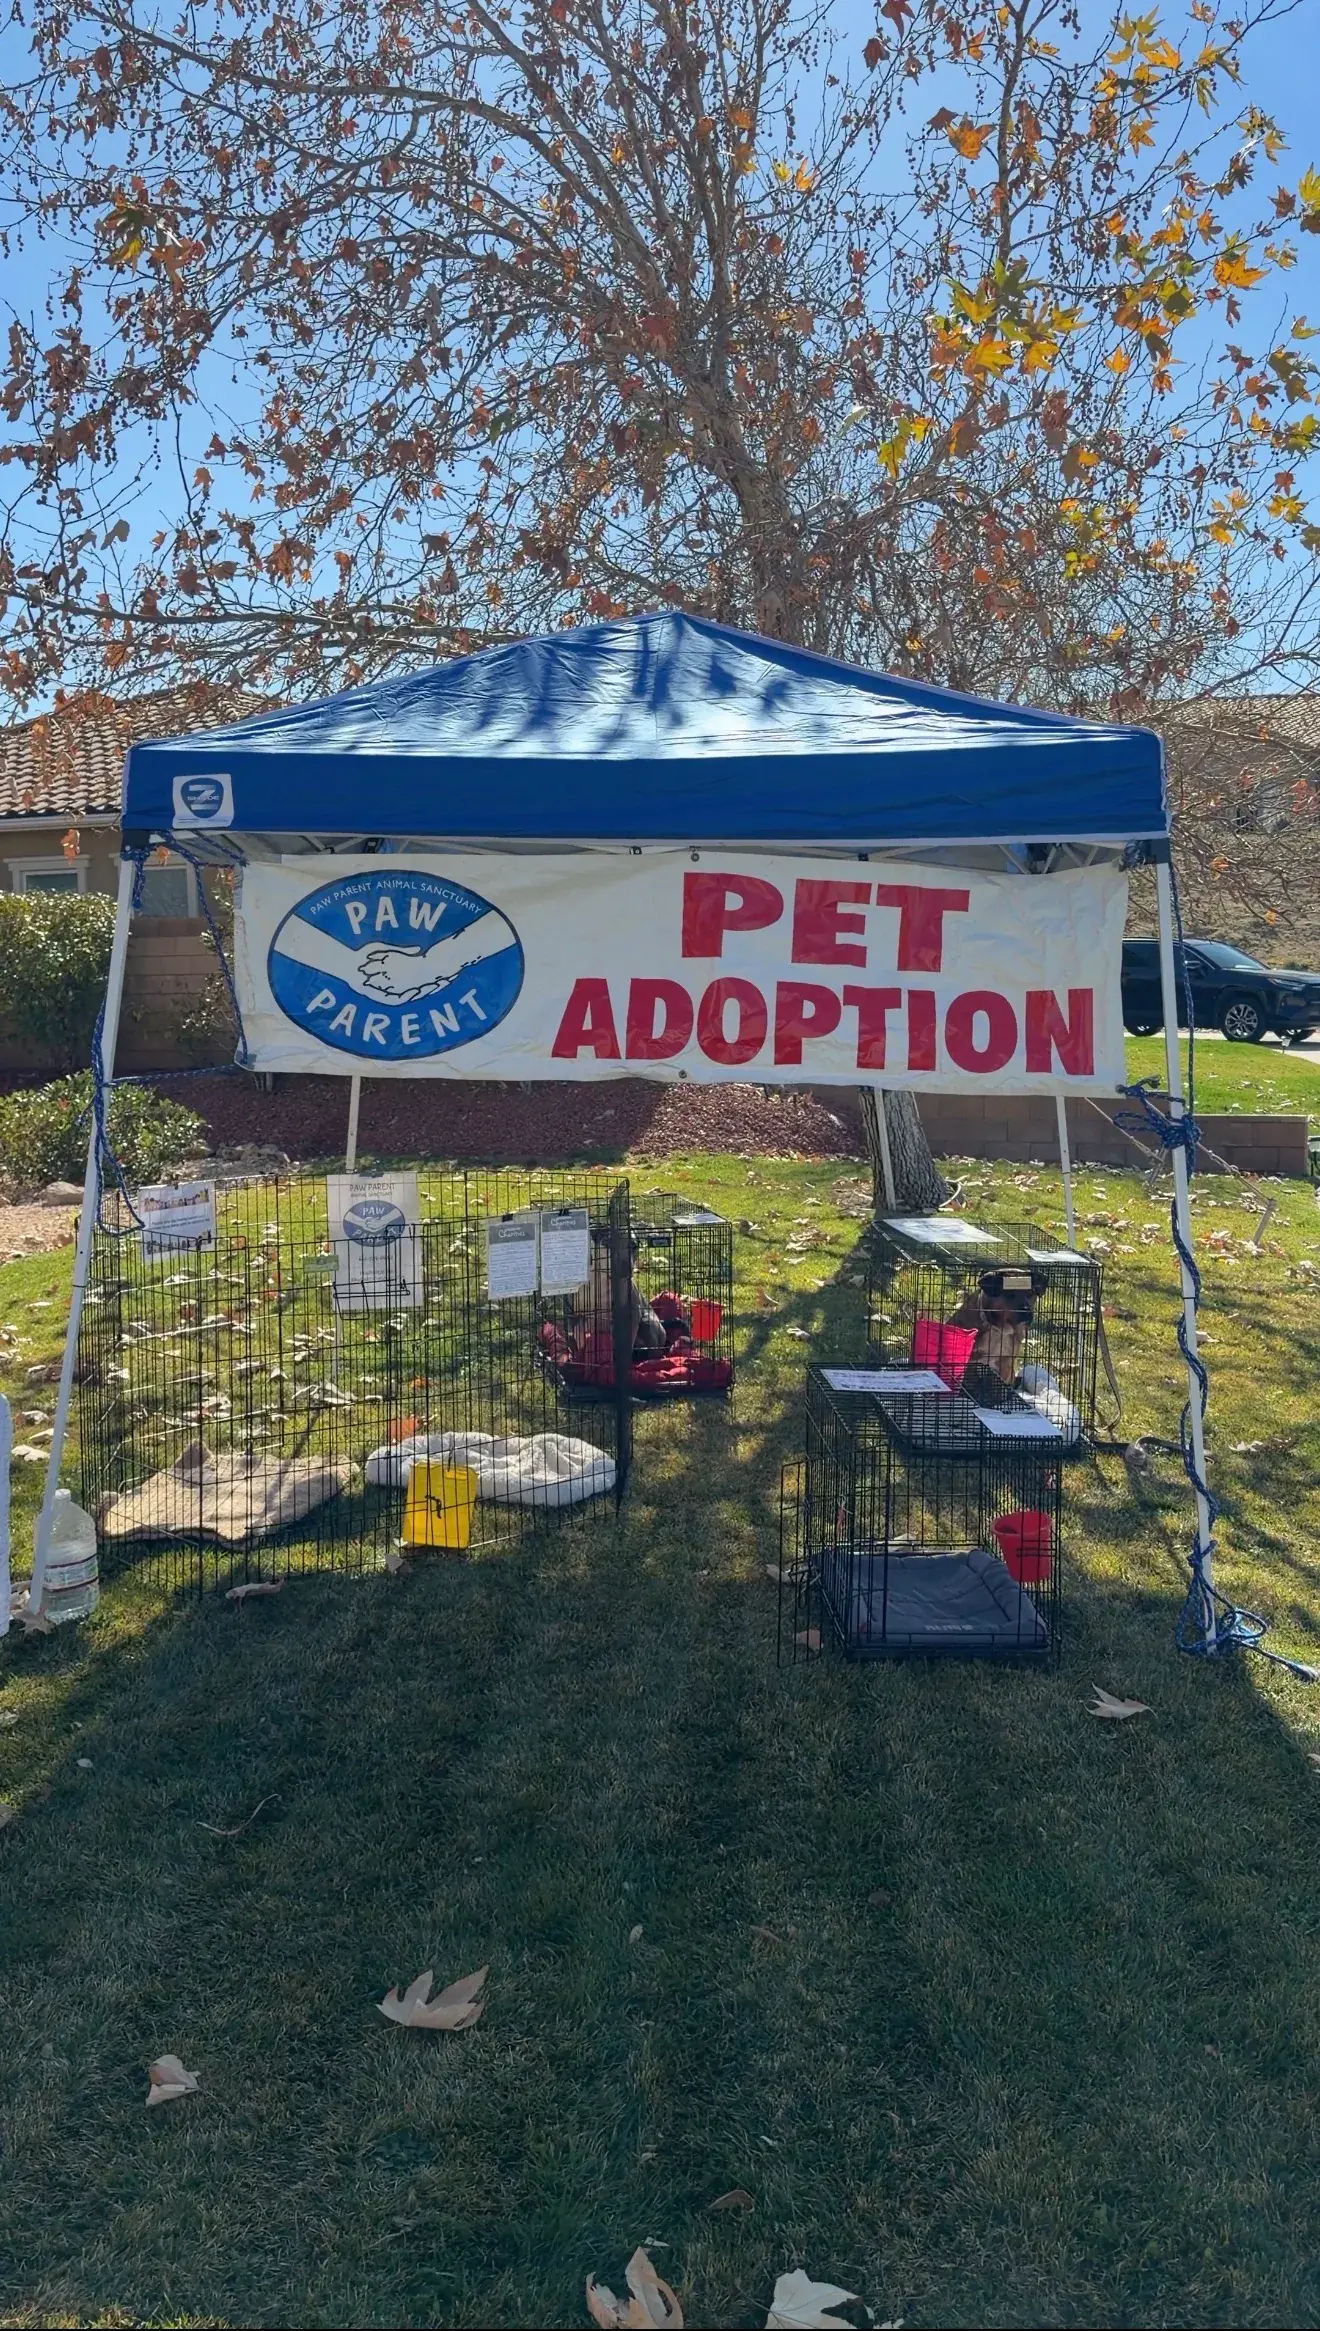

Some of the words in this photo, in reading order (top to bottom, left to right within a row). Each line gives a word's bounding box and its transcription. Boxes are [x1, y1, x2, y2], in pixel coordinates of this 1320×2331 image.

[310, 897, 332, 915] PAW
[333, 882, 372, 901] PARENT
[376, 880, 417, 890] ANIMAL
[420, 883, 482, 915] SANCTUARY
[345, 896, 447, 935] PAW
[682, 872, 970, 973] PET
[305, 988, 488, 1045] PARENT
[551, 976, 1095, 1076] ADOPTION
[349, 1184, 367, 1192] PAW
[368, 1183, 396, 1191] PARENT
[362, 1206, 385, 1216] PAW
[352, 1228, 398, 1243] PARET
